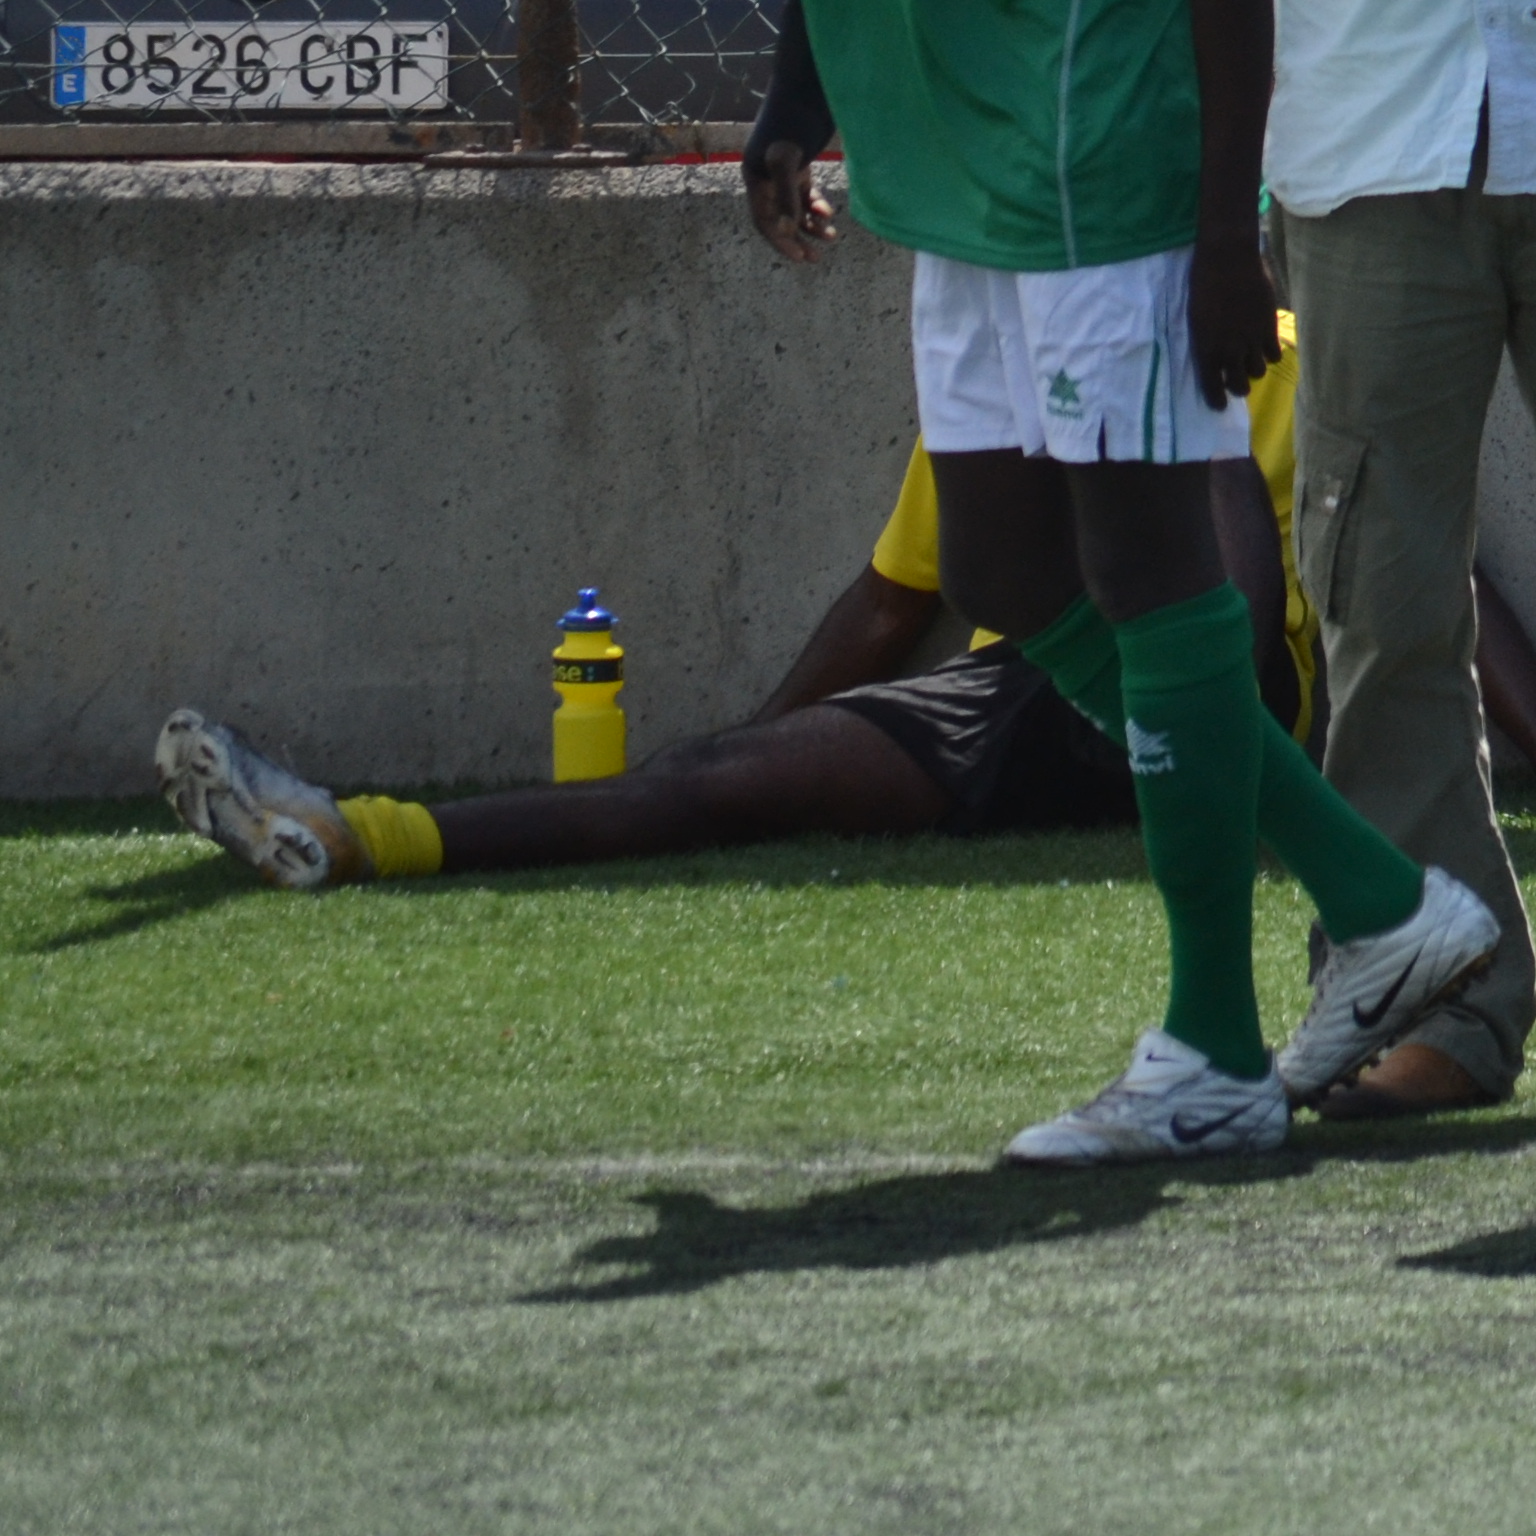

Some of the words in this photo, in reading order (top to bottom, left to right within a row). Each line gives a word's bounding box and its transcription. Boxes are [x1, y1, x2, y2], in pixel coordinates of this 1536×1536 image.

[62, 73, 76, 92] E
[102, 33, 271, 96] 8526
[300, 33, 428, 96] CBF
